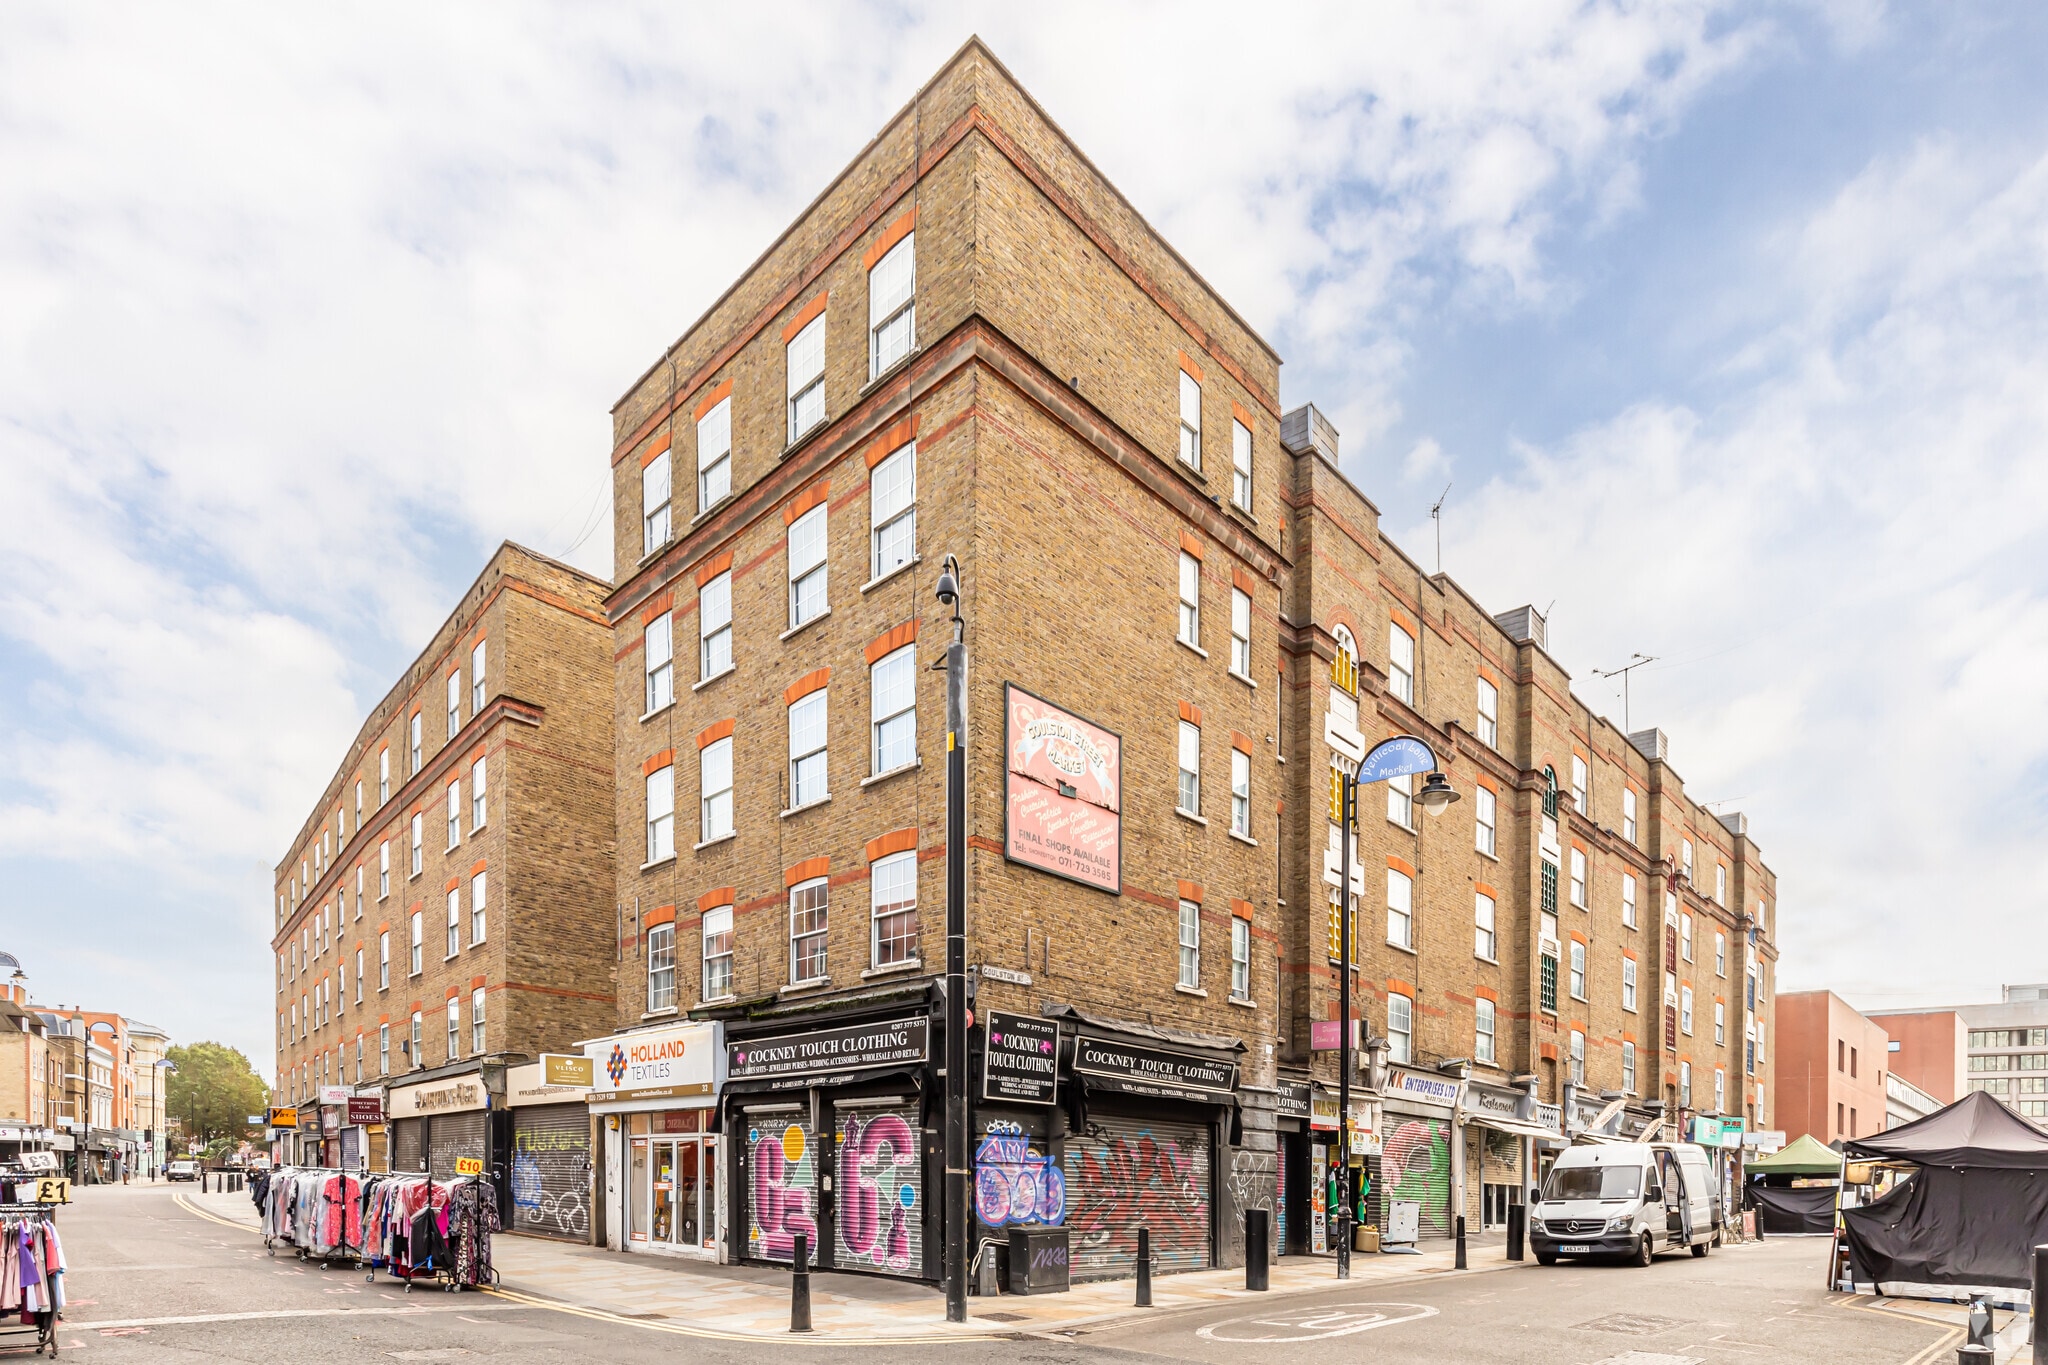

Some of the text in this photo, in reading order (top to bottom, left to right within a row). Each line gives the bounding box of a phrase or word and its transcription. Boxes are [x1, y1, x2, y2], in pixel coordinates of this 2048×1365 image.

[1028, 722, 1104, 768] GOULSTON STREET
[1048, 748, 1085, 774] MARKET
[1363, 742, 1428, 776] Petticoat Lane
[1379, 763, 1413, 777] Market
[1010, 788, 1039, 807] Fashion
[1020, 797, 1049, 818] Curtains
[1035, 806, 1062, 827] Fabrics
[1047, 807, 1089, 834] Leather Goods
[1018, 829, 1111, 869] FINAL SHOPS AVAILABLE
[1095, 836, 1115, 851] Shoes
[1013, 840, 1027, 854] Tel:
[1092, 867, 1111, 881] 3585
[903, 1021, 913, 1029] 377
[913, 1019, 926, 1028] 5373
[631, 1040, 685, 1063] HOLLAND
[748, 1045, 797, 1063] COCKNEY
[800, 1039, 839, 1057] TOUCH
[842, 1031, 908, 1052] CLOTHING
[1003, 1033, 1041, 1053] COCKNEY
[555, 1065, 584, 1073] VLISCO
[769, 1062, 792, 1072] JEWELLERY
[792, 1061, 807, 1070] PURSES
[809, 1058, 829, 1067] WEDDING
[830, 1055, 859, 1066] ACCESSORIES
[862, 1051, 892, 1062] WHOLESALE
[892, 1050, 902, 1059] AND
[902, 1048, 921, 1058] RETAIL
[988, 1050, 1054, 1074] TOUCH CLOTHING
[1085, 1049, 1225, 1083] COCKNEY TOUCH CLOTHING
[631, 1062, 671, 1081] TEXTILES
[1130, 1068, 1158, 1078] WHOLESALE
[1168, 1074, 1183, 1082] RETAIL
[701, 1084, 708, 1092] 32
[1387, 1070, 1456, 1099] KK ENTERPRISES LTD
[1479, 1091, 1516, 1113] Restaurant
[28, 1155, 51, 1168] £3
[459, 1159, 480, 1172] £10
[41, 1181, 66, 1199] £1
